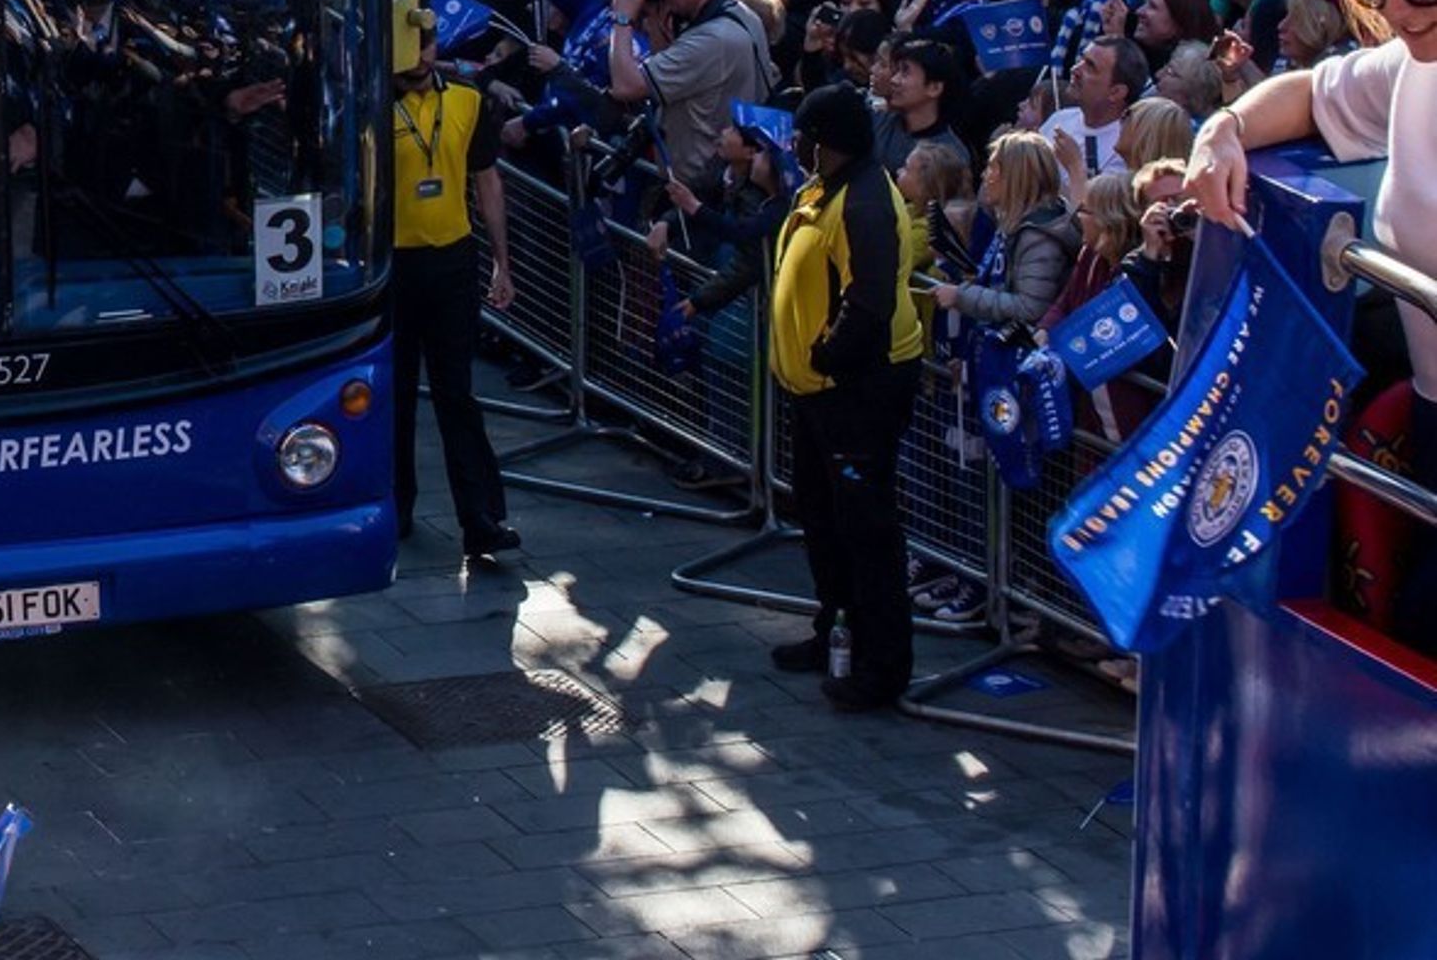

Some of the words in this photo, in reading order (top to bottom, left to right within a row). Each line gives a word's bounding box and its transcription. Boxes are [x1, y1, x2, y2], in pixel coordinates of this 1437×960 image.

[265, 208, 314, 274] 3
[1135, 371, 1230, 488] CHAMPIONS
[1259, 378, 1344, 522] FOREVER
[21, 587, 82, 621] FOK
